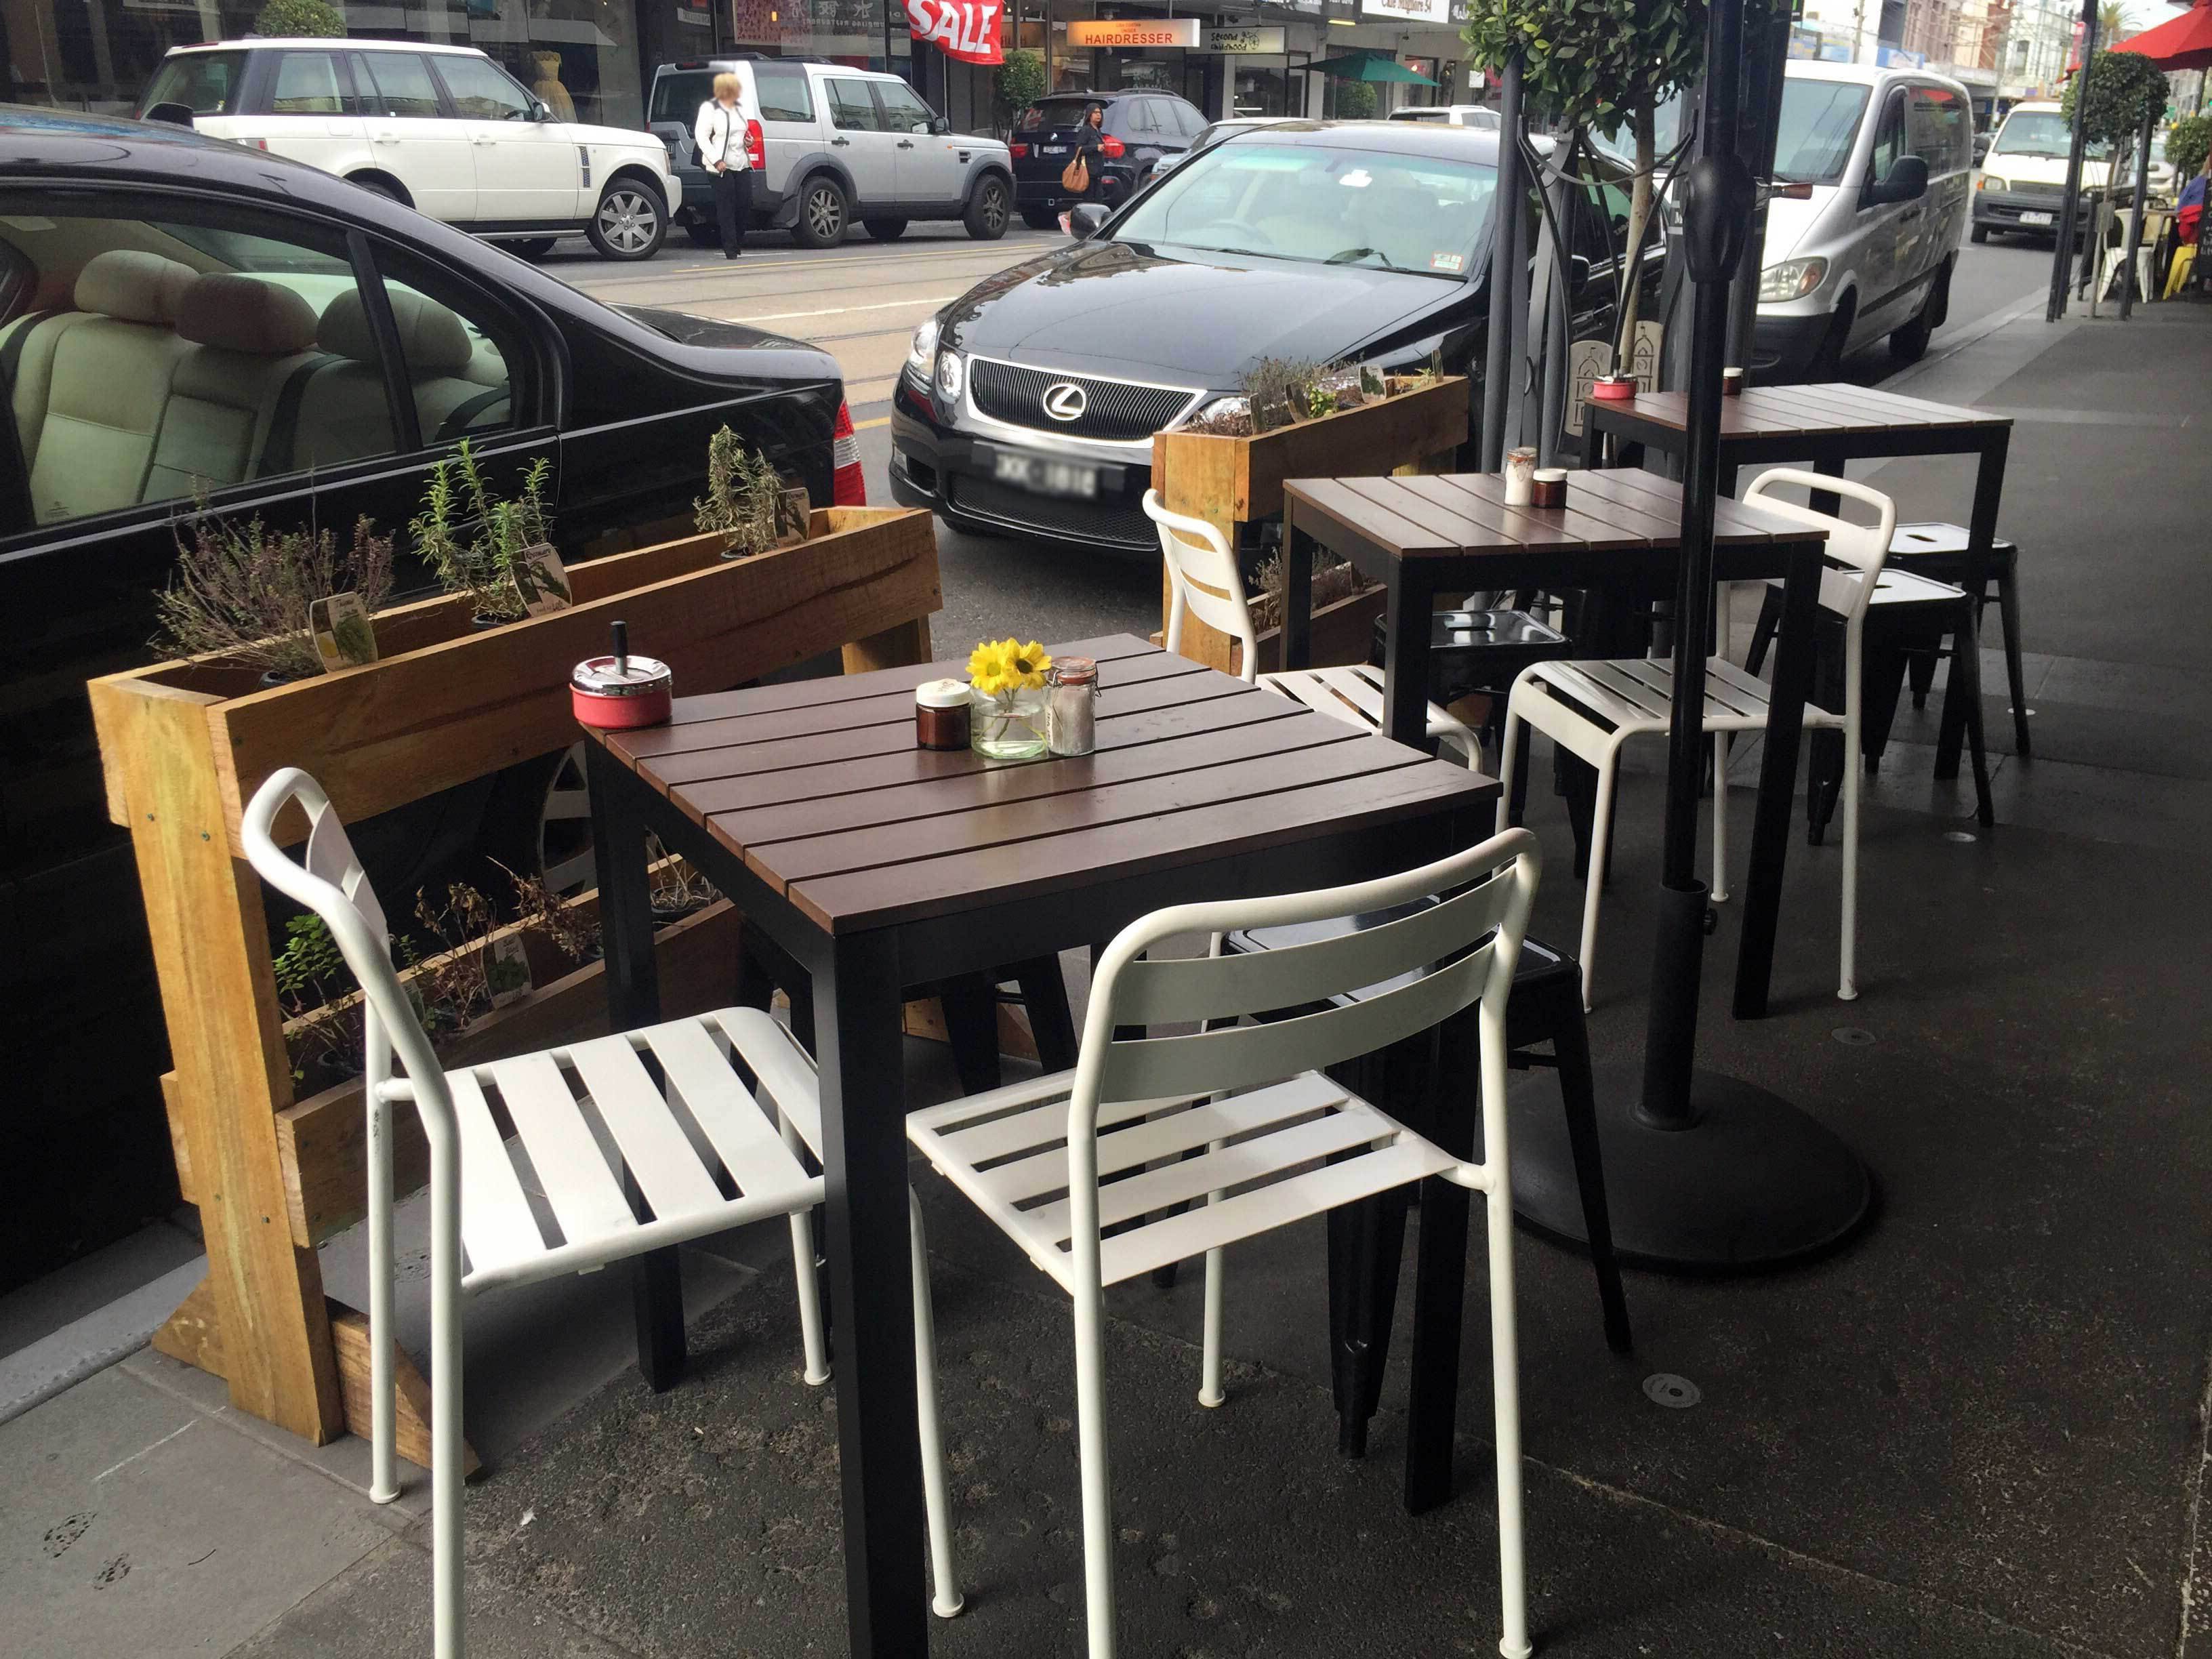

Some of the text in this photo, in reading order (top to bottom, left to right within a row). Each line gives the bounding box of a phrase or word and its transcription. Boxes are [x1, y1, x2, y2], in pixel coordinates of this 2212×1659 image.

[908, 0, 997, 53] SALE
[1085, 33, 1173, 44] HAIRDRESSER
[1211, 31, 1238, 41] second
[1210, 43, 1247, 51] childhood
